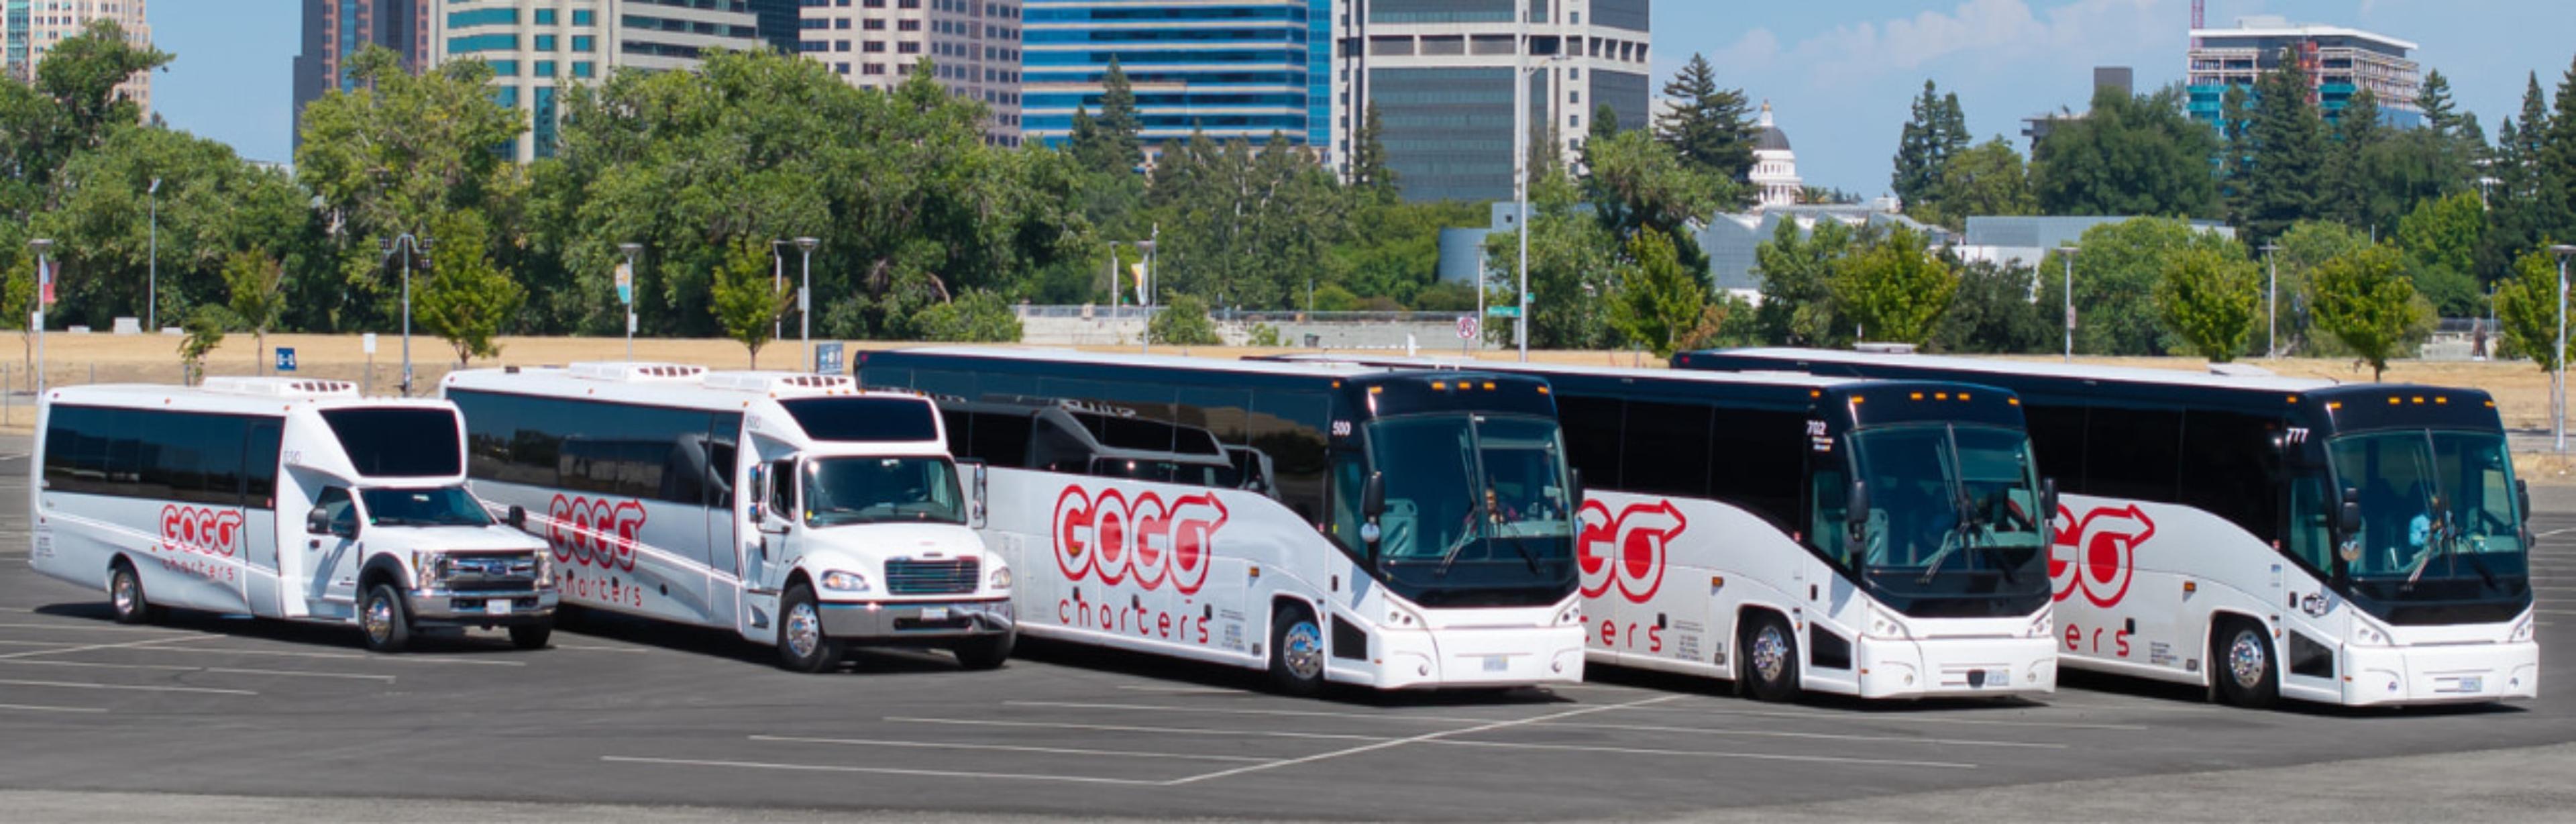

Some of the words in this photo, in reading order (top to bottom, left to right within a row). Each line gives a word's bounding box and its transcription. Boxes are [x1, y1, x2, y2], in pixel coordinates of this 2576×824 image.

[1332, 420, 1350, 435] 500
[2285, 427, 2309, 445] 777
[160, 504, 243, 558] GOGO
[546, 493, 647, 573] GOGO
[1053, 484, 1228, 595] GOGO
[1059, 589, 1209, 644] charters
